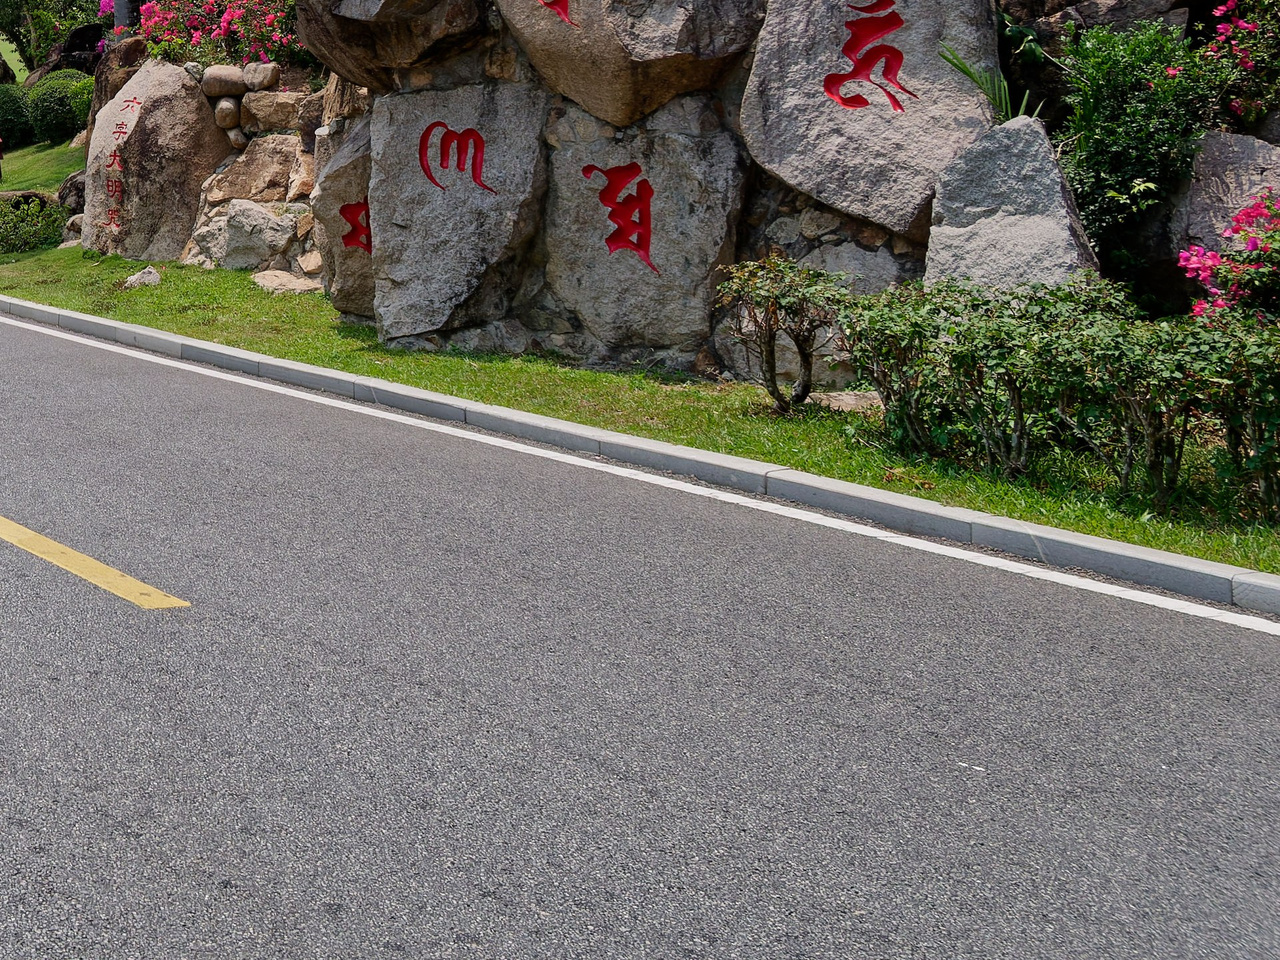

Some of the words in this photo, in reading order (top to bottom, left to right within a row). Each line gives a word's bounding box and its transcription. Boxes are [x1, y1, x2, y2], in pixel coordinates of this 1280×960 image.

[103, 96, 142, 228] 六字大明咒
